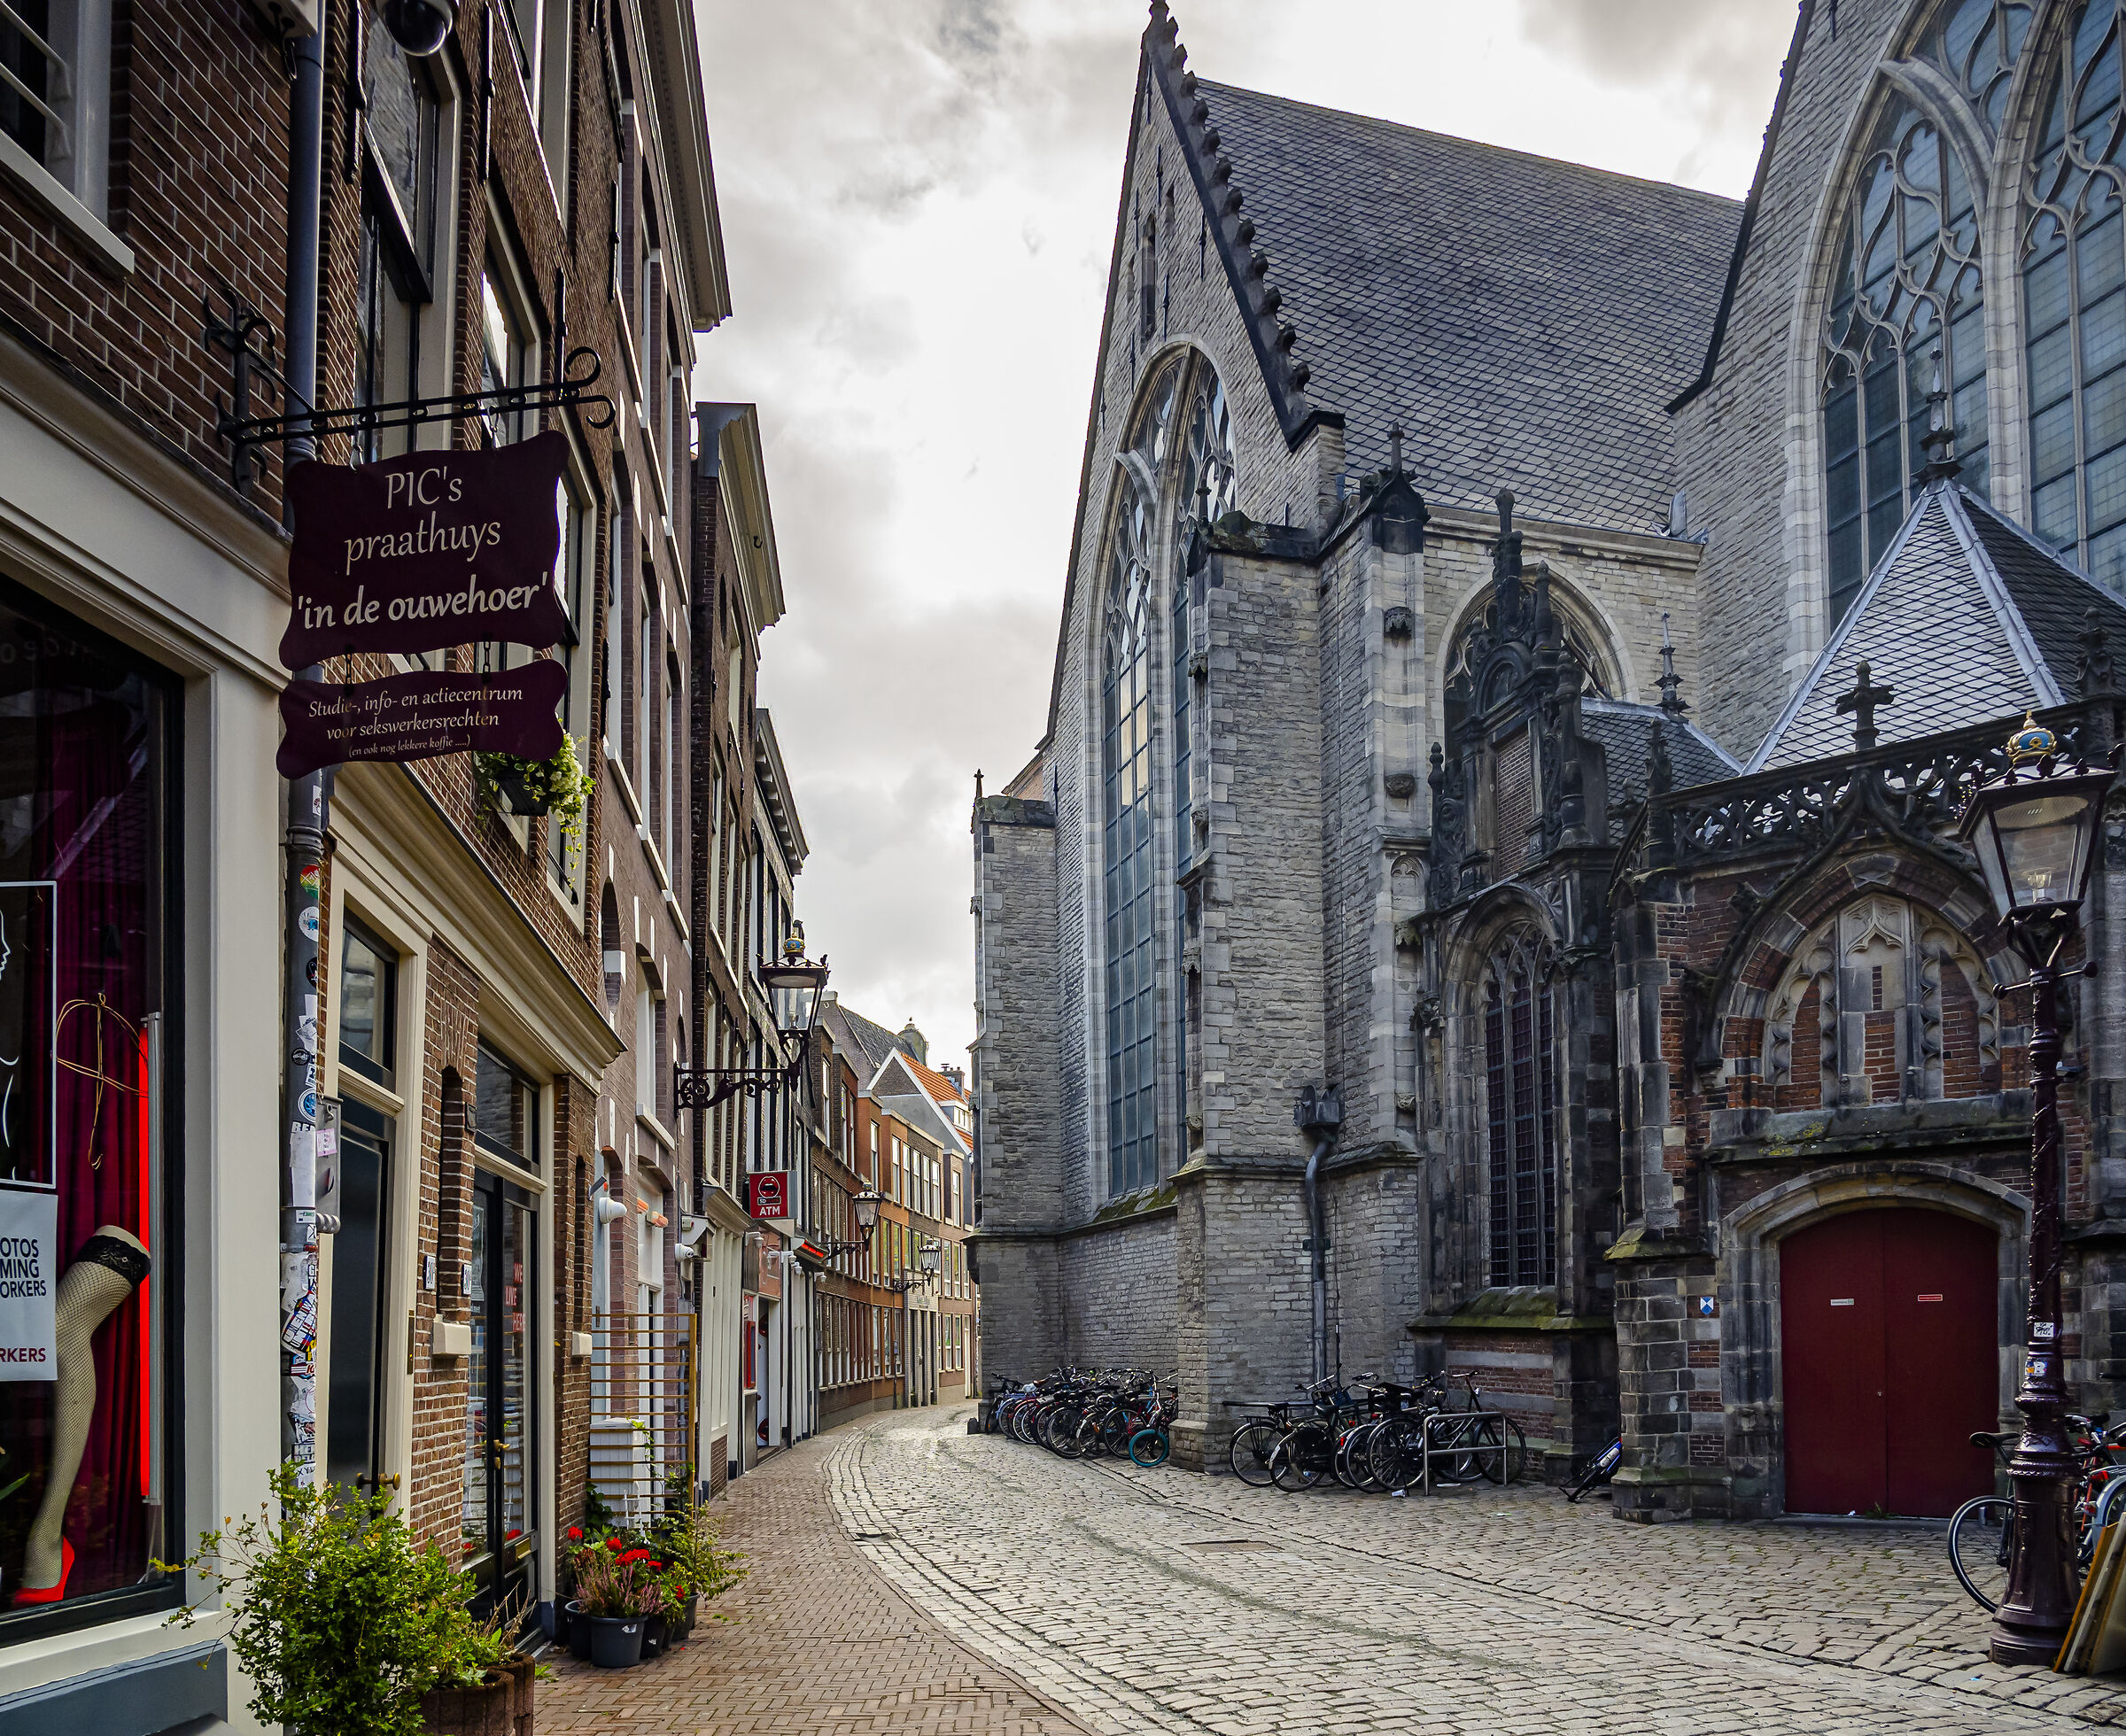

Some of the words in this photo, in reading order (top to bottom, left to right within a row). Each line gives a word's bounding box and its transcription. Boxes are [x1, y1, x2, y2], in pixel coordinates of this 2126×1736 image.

[384, 466, 462, 509] PIC's
[344, 511, 501, 576] praathuys
[343, 585, 380, 625] de
[387, 571, 548, 621] ouwehoer'
[308, 695, 361, 717] Studie-,
[365, 691, 398, 716] info-
[401, 694, 418, 707] en
[422, 686, 523, 705] actiecentrum
[327, 726, 357, 740] voor
[359, 709, 500, 736] sekswerkersrechten
[363, 742, 378, 755] ook
[380, 745, 396, 756] nog
[398, 739, 427, 751] lekkere
[429, 735, 454, 751] koffie
[759, 1205, 780, 1216] ATM
[514, 1262, 524, 1283] WE
[505, 1286, 517, 1306] LIVE
